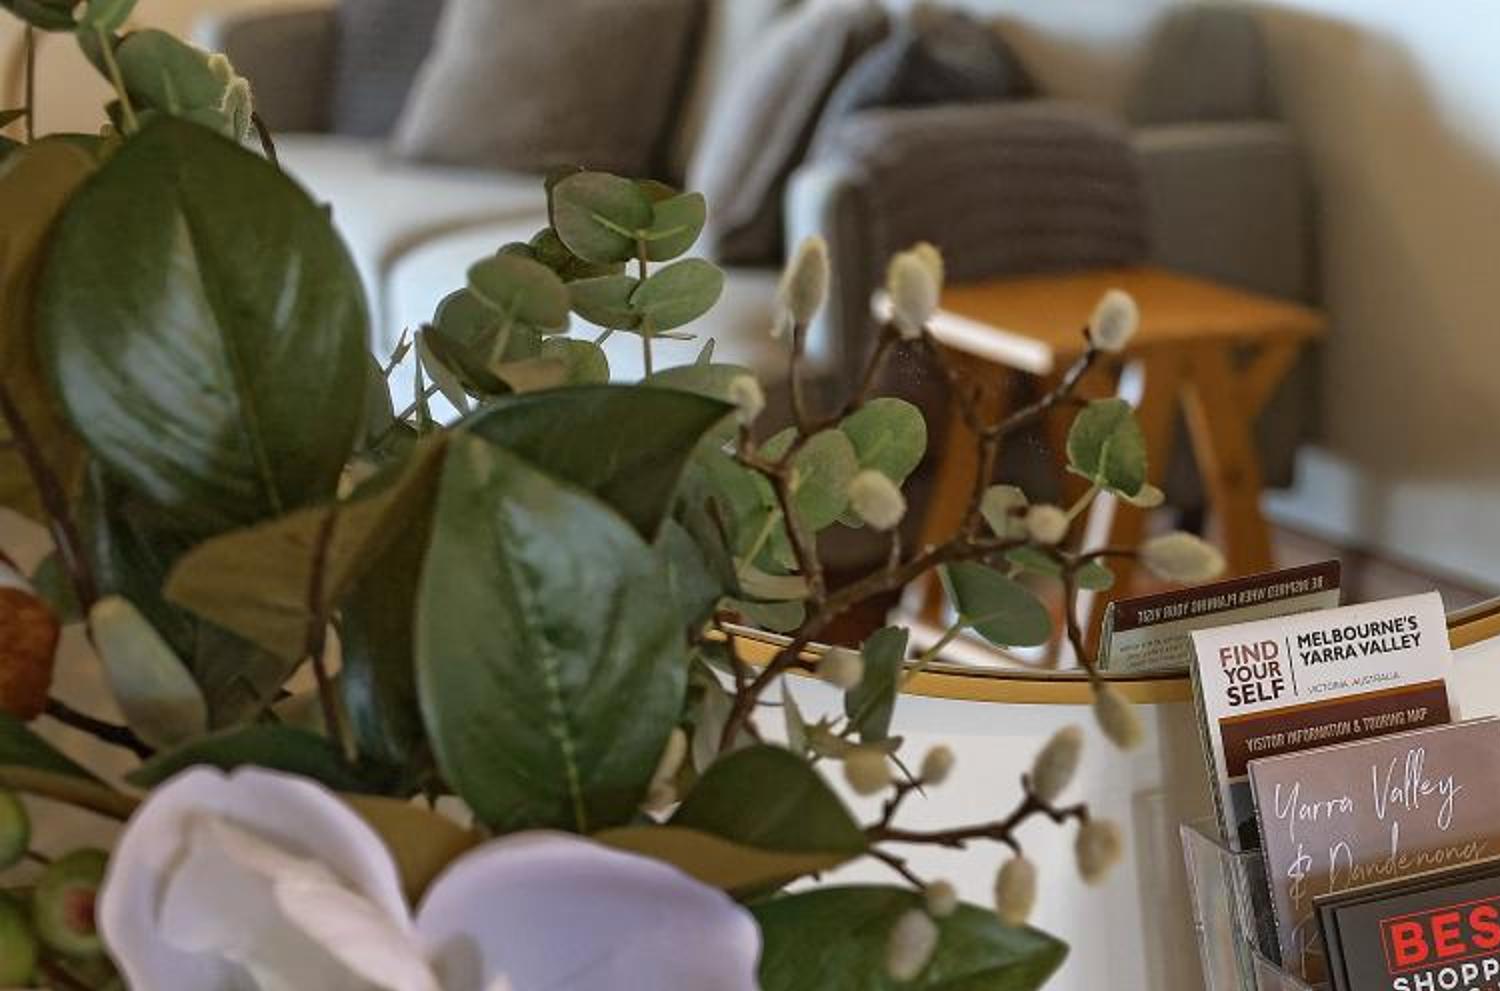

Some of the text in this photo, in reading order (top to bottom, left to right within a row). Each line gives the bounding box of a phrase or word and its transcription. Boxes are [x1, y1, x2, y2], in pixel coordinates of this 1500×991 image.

[1297, 615, 1420, 650] MELBOURNE'S
[1218, 638, 1280, 668] FIND
[1300, 632, 1422, 667] YARRA VALLEY
[1223, 661, 1282, 685] YOUR
[1352, 670, 1401, 687] AUSTRALIA
[1226, 682, 1286, 708] SELF
[1245, 706, 1429, 753] VISITOR INFORMATION & TOURING MAP
[1274, 747, 1463, 842] Yarra Valley
